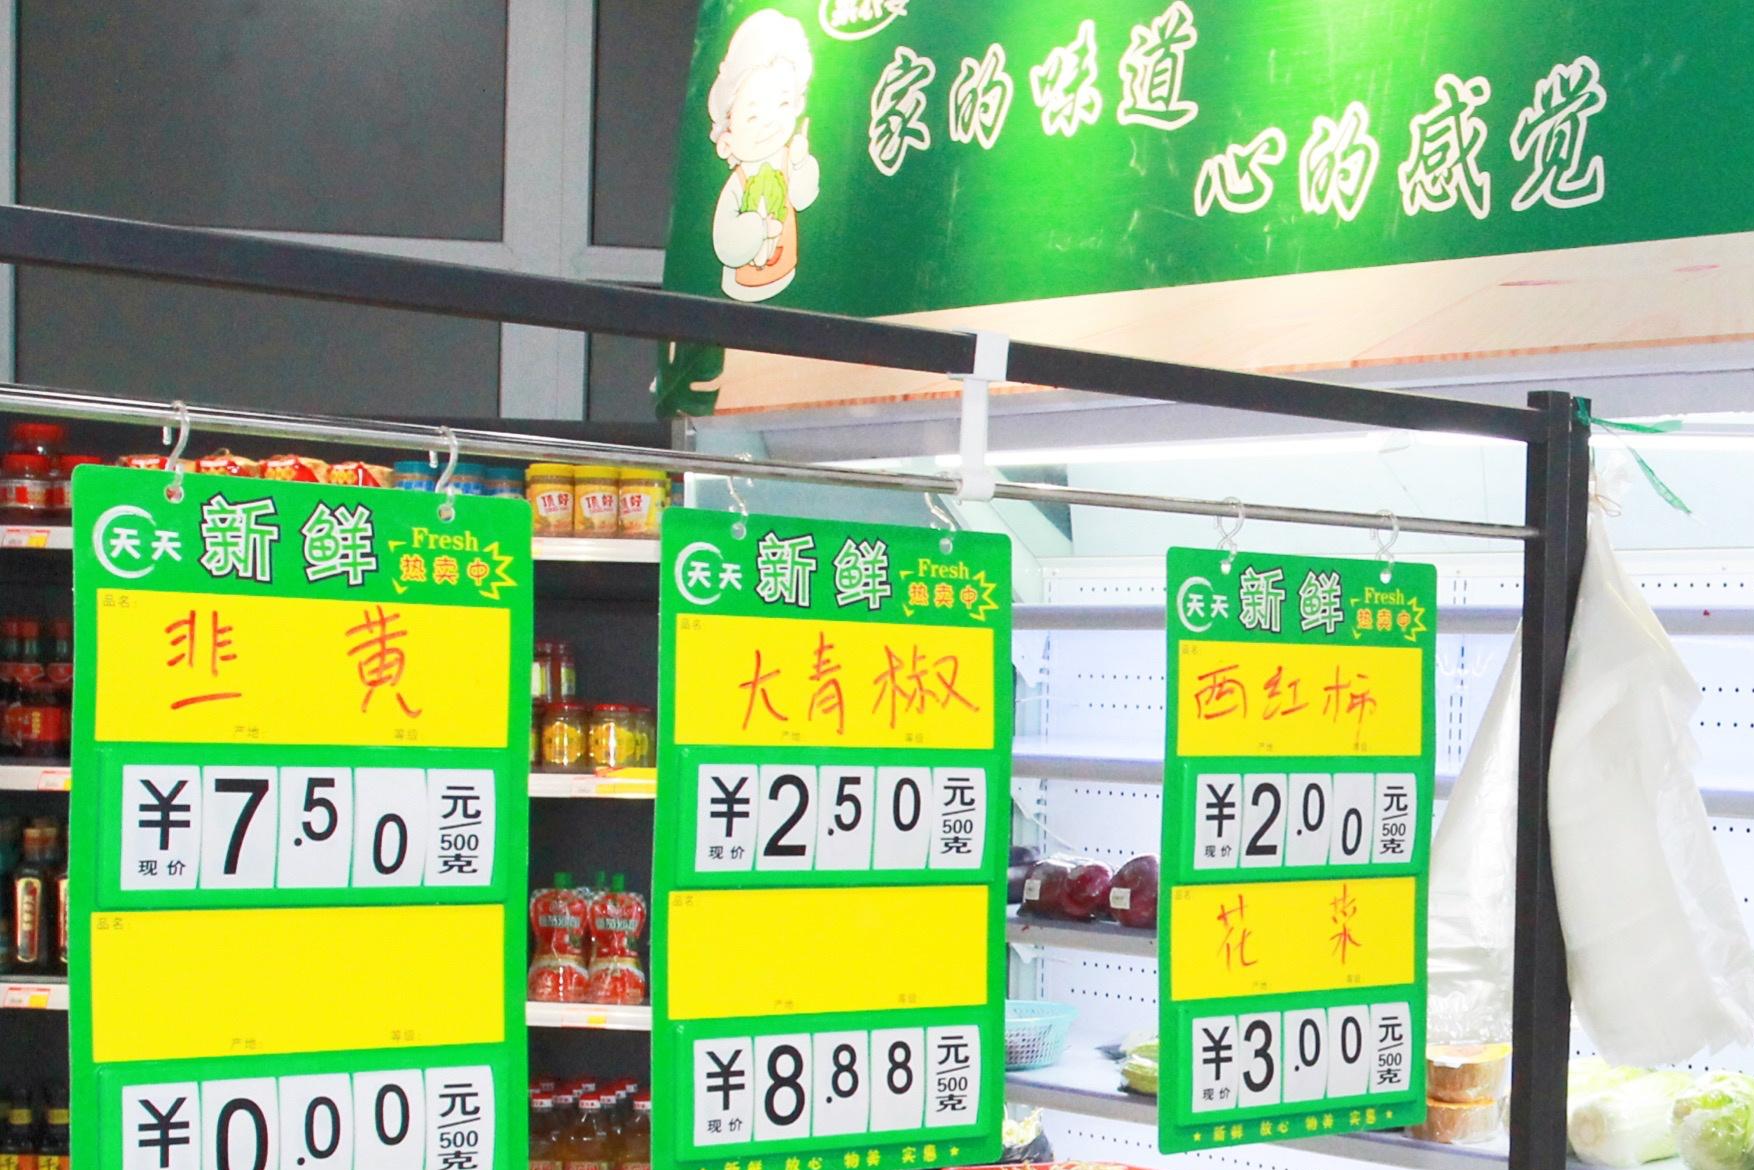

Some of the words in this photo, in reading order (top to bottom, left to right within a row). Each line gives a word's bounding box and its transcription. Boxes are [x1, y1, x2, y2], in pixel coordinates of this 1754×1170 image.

[868, 1, 1199, 176] 家的味道
[1194, 55, 1607, 221] 心的感觉
[109, 528, 182, 561] 天天
[200, 492, 377, 587] 新鲜
[411, 527, 479, 552] Fresh
[400, 555, 491, 585] 热卖中
[688, 560, 743, 591] 天天
[754, 530, 892, 611] 新鲜
[918, 558, 970, 580] Fresh
[908, 582, 979, 609] 热卖中
[1187, 593, 1229, 619] 天天
[1238, 564, 1344, 634] 新鲜
[1364, 587, 1405, 606] Fresh
[164, 606, 422, 718] 韭黄
[739, 631, 980, 735] 大青椒
[708, 846, 745, 860] 现价
[1204, 845, 1232, 858] 现价
[138, 860, 186, 876] 现价
[1217, 883, 1361, 971] 花菜
[1202, 1087, 1231, 1101] 现价
[707, 1118, 743, 1134] 现价
